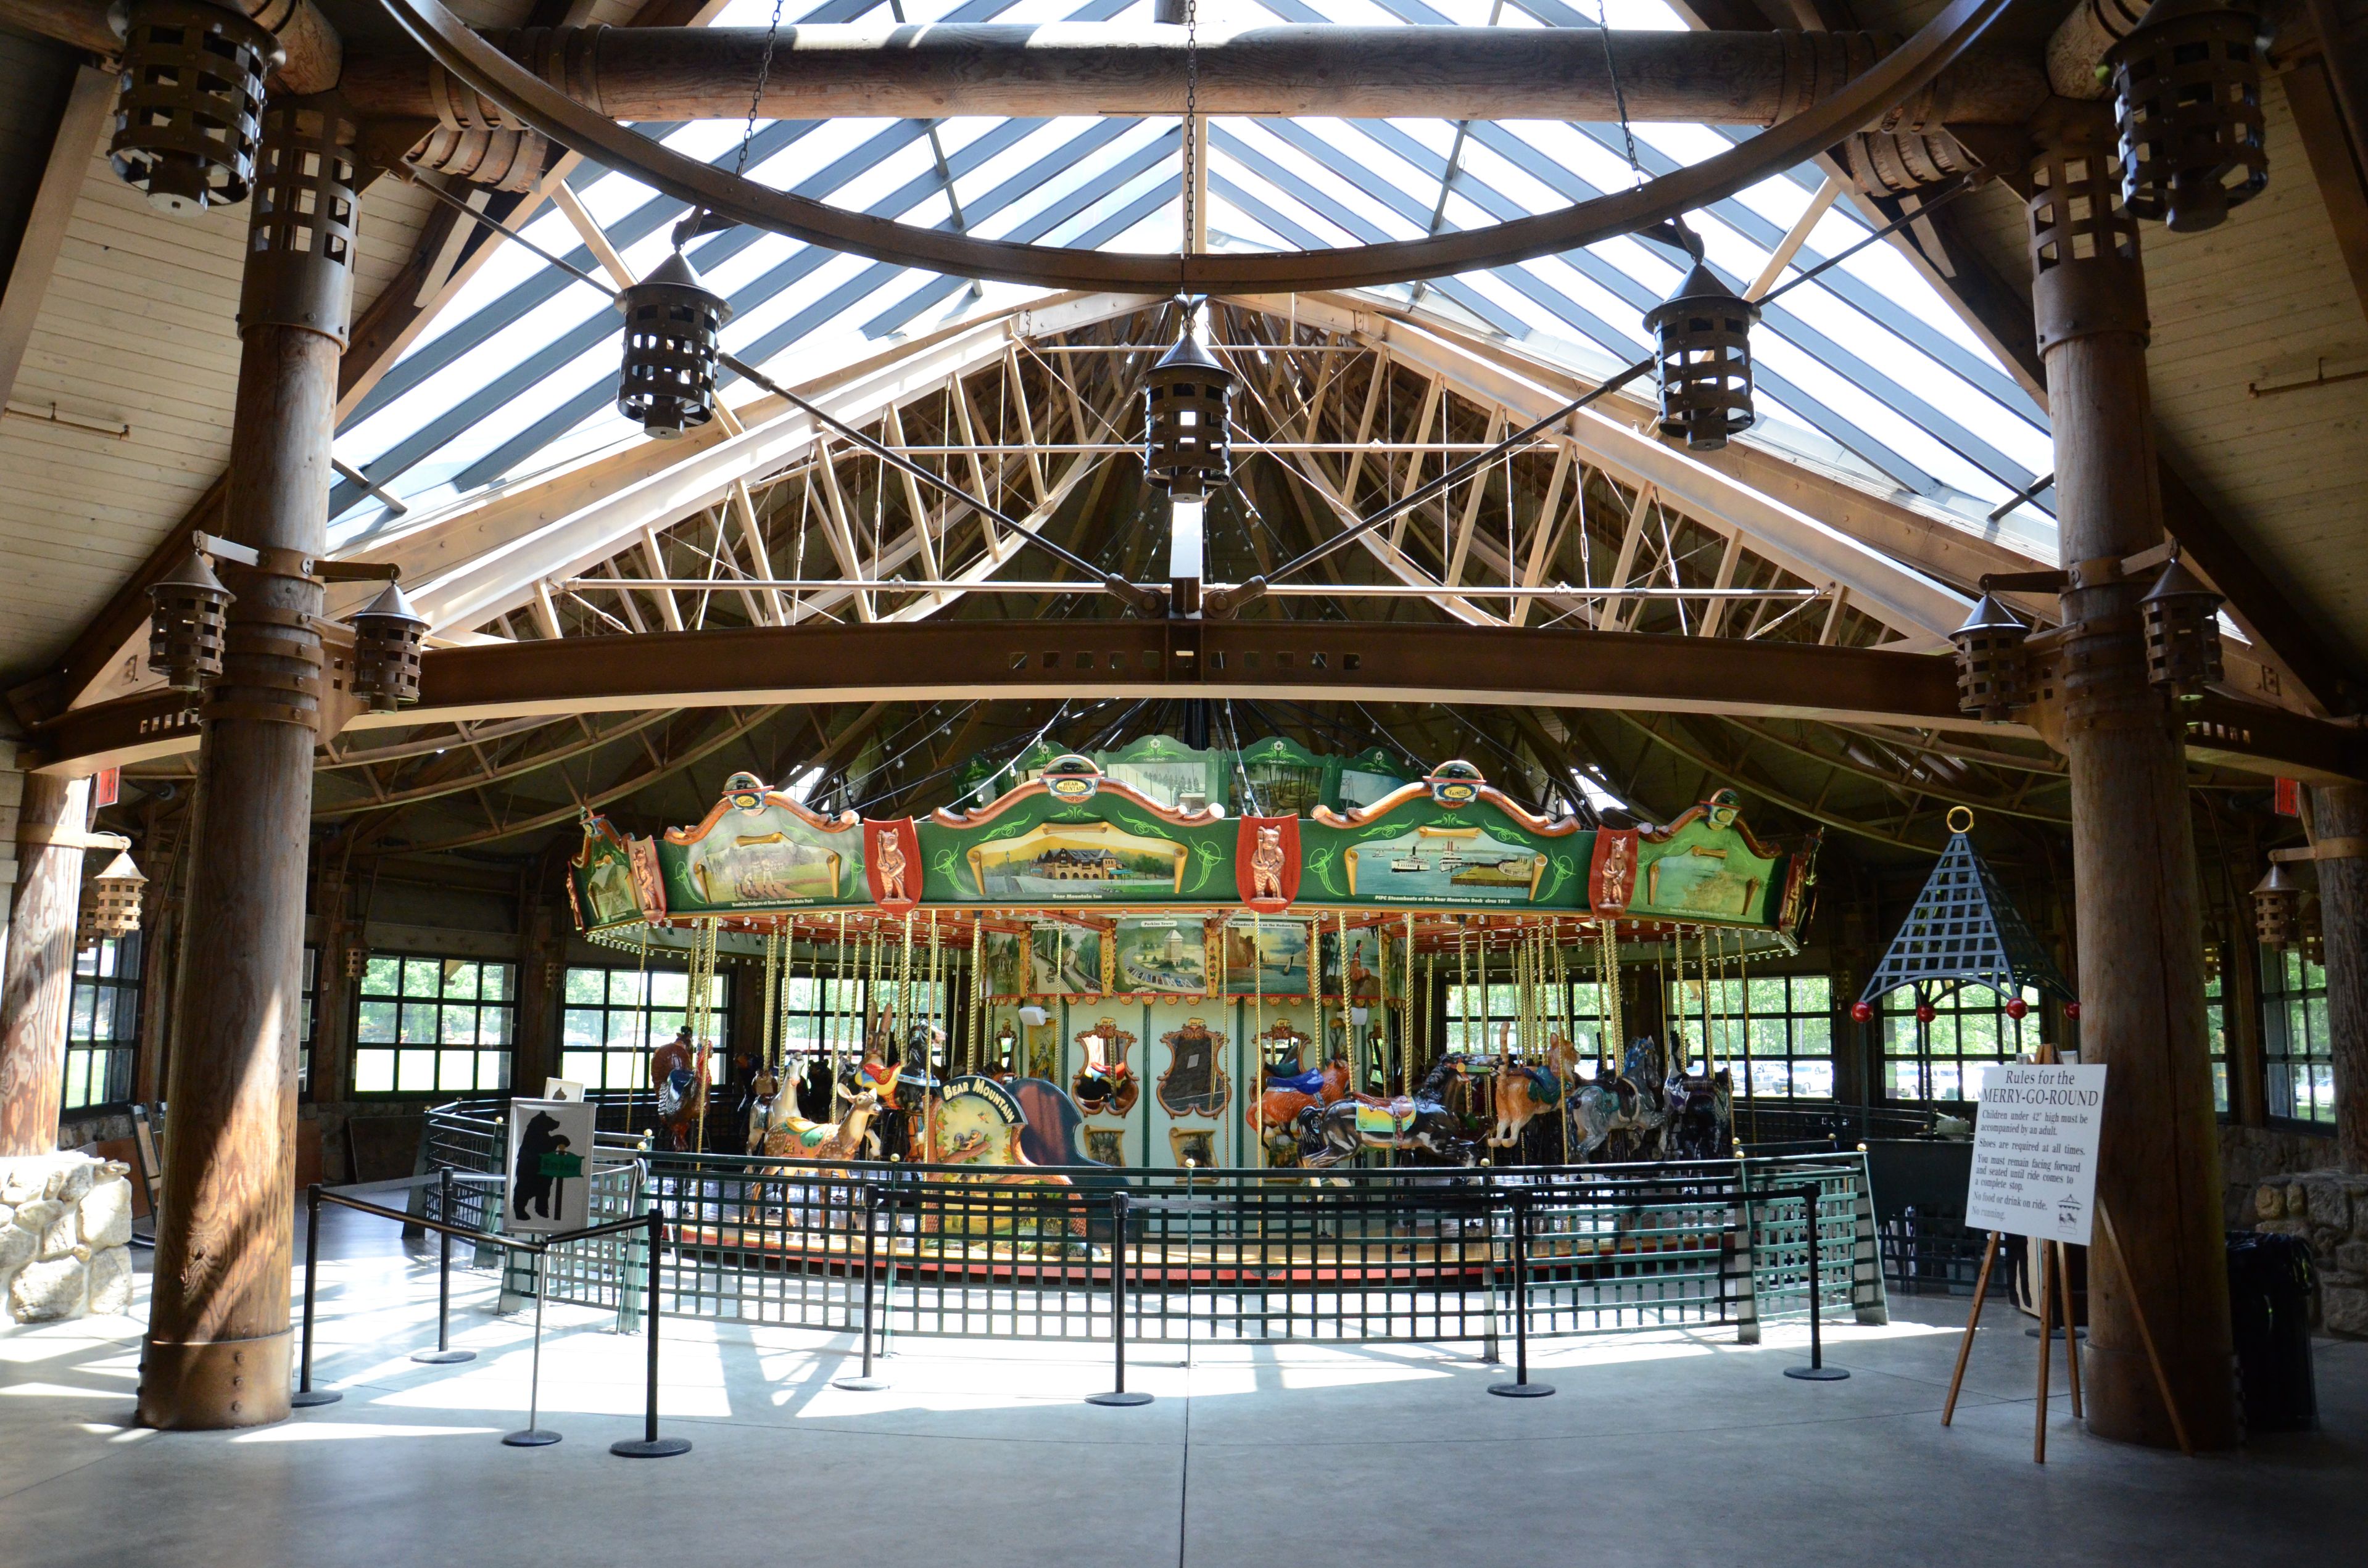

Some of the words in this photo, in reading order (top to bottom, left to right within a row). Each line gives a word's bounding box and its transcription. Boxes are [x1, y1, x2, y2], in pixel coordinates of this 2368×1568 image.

[2006, 1070, 2035, 1084] Rules
[2038, 1070, 2055, 1084] for
[2058, 1070, 2075, 1085] the
[1982, 1088, 2098, 1106] MERRY-GO-ROUND
[1982, 1109, 2008, 1120] Children
[2010, 1112, 2029, 1121] under
[2045, 1112, 2059, 1124] high
[2061, 1114, 2077, 1123] must
[2080, 1113, 2088, 1124] be
[1981, 1123, 2019, 1134] accompanied
[2021, 1124, 2027, 1136] by
[2039, 1125, 2058, 1136] adult.
[1979, 1138, 1996, 1148] Shoes
[1998, 1141, 2009, 1149] are
[2011, 1141, 2039, 1153] required
[2042, 1144, 2050, 1152] at
[2052, 1144, 2061, 1153] all
[2064, 1144, 2085, 1155] times.
[1977, 1153, 1988, 1163] You
[1990, 1157, 2005, 1165] must
[2008, 1157, 2029, 1167] remain
[2032, 1158, 2051, 1171] facing
[2054, 1161, 2080, 1173] forward
[1976, 1165, 1986, 1174] and
[1989, 1167, 2008, 1177] seated
[2010, 1170, 2024, 1179] until
[2027, 1171, 2040, 1181] ride
[2043, 1174, 2063, 1183] comes
[2067, 1175, 2074, 1184] to
[1981, 1178, 2006, 1190] complete
[2009, 1181, 2023, 1192] stop.
[1973, 1190, 1982, 1200] No
[1982, 1192, 1995, 1202] food
[2005, 1195, 2021, 1207] drink
[2022, 1199, 2031, 1207] on
[2032, 1200, 2048, 1210] ride.
[1971, 1206, 1980, 1215] No
[1981, 1208, 2005, 1221] running.
